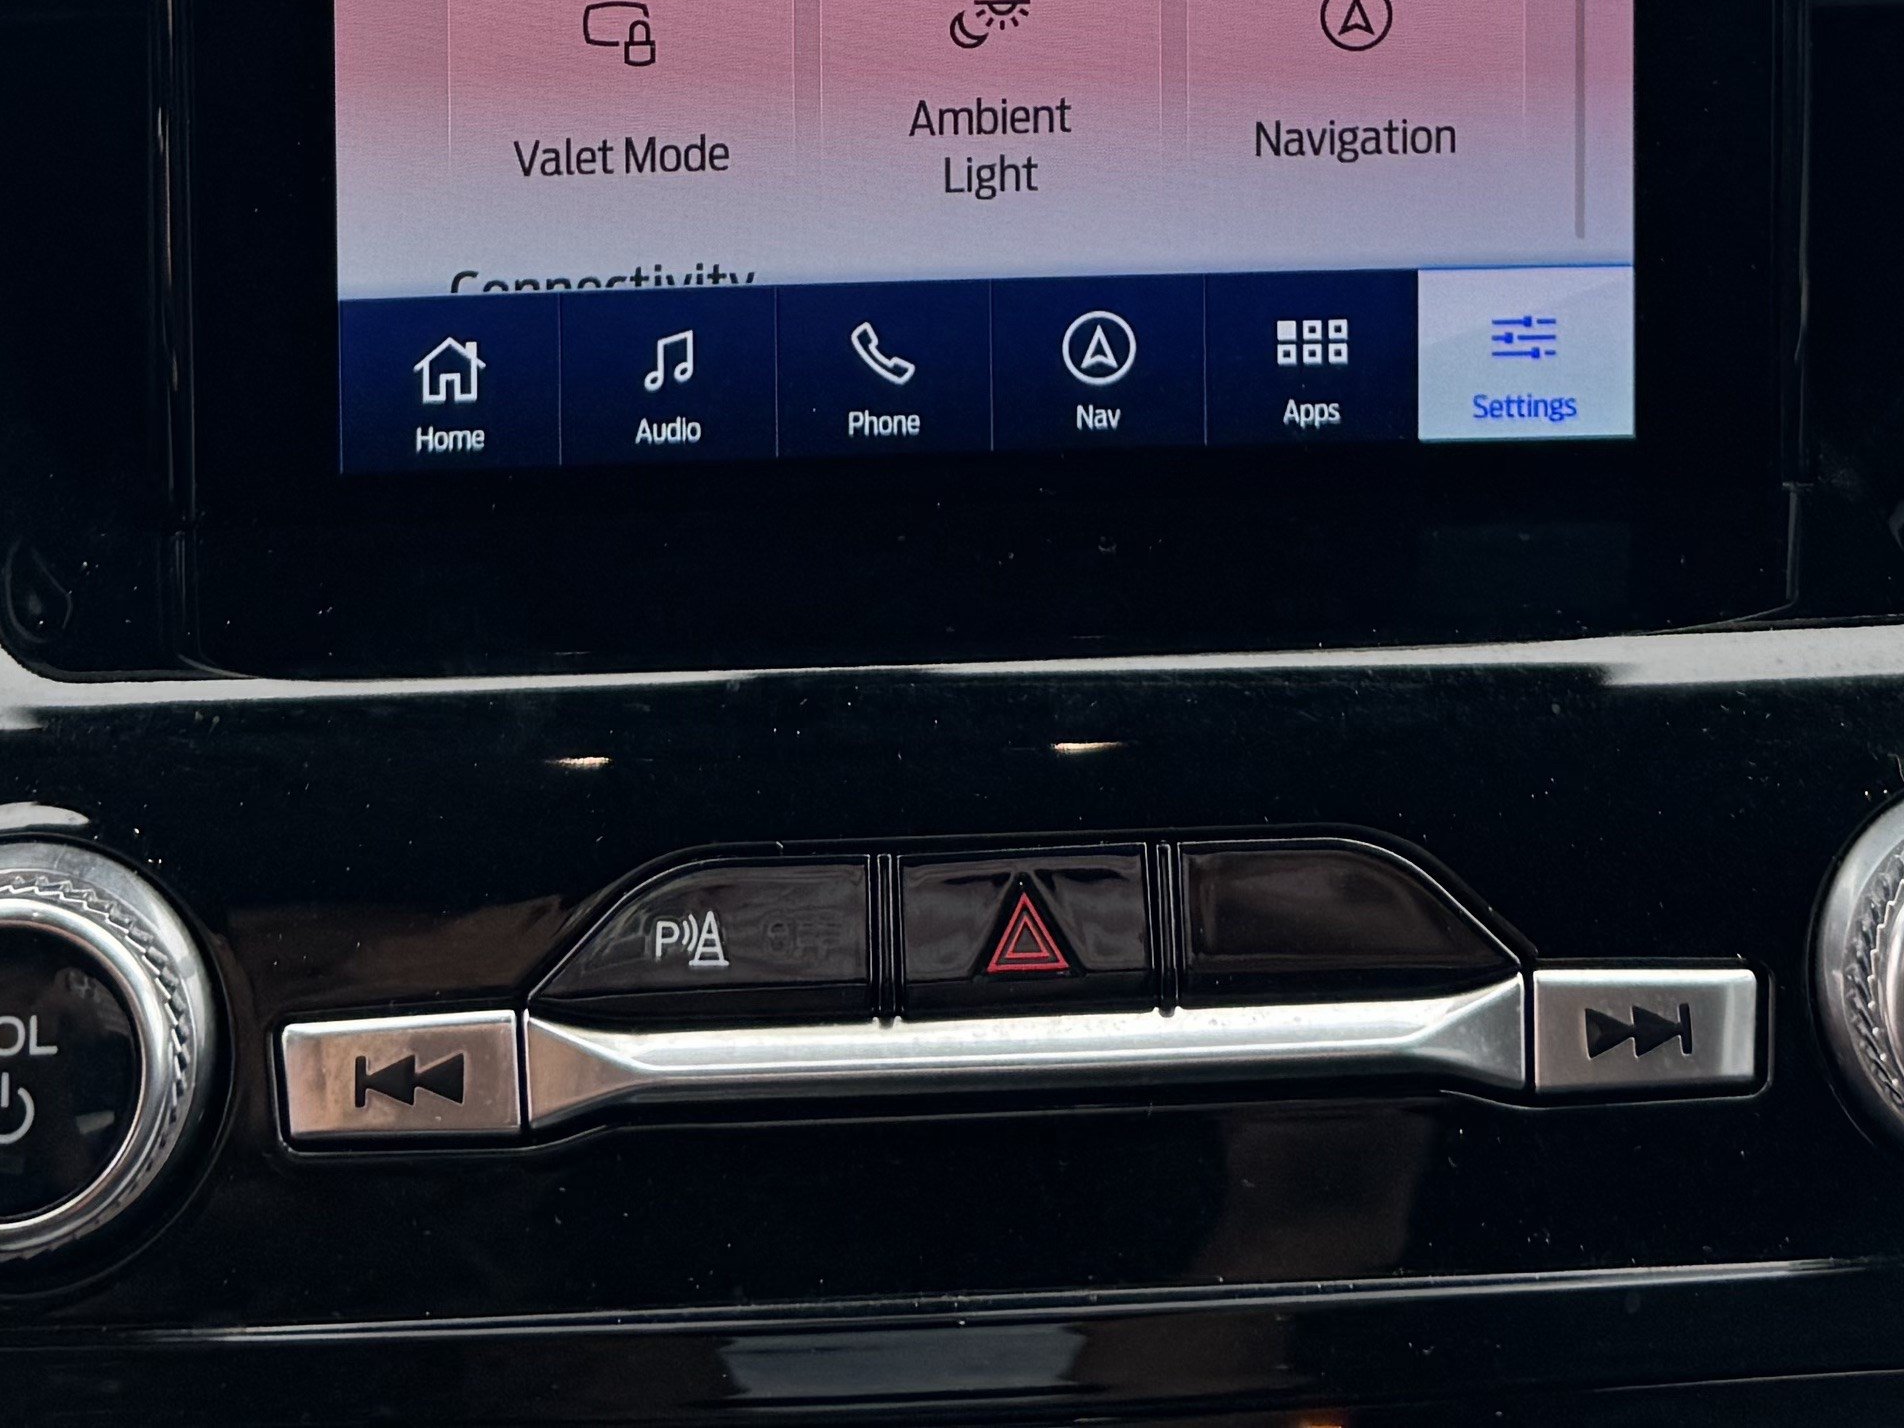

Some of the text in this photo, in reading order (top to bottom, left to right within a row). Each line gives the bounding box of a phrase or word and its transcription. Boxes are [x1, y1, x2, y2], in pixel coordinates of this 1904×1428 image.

[909, 97, 1072, 137] Ambient
[513, 133, 730, 177] Valet Mode
[1255, 118, 1456, 163] Navigation
[944, 154, 1038, 200] Light
[848, 409, 921, 436] Phone
[1076, 404, 1121, 429] Nav
[1283, 399, 1341, 428] Apps
[1473, 394, 1578, 423] Settings
[416, 426, 485, 452] Home
[635, 416, 702, 444] Audio
